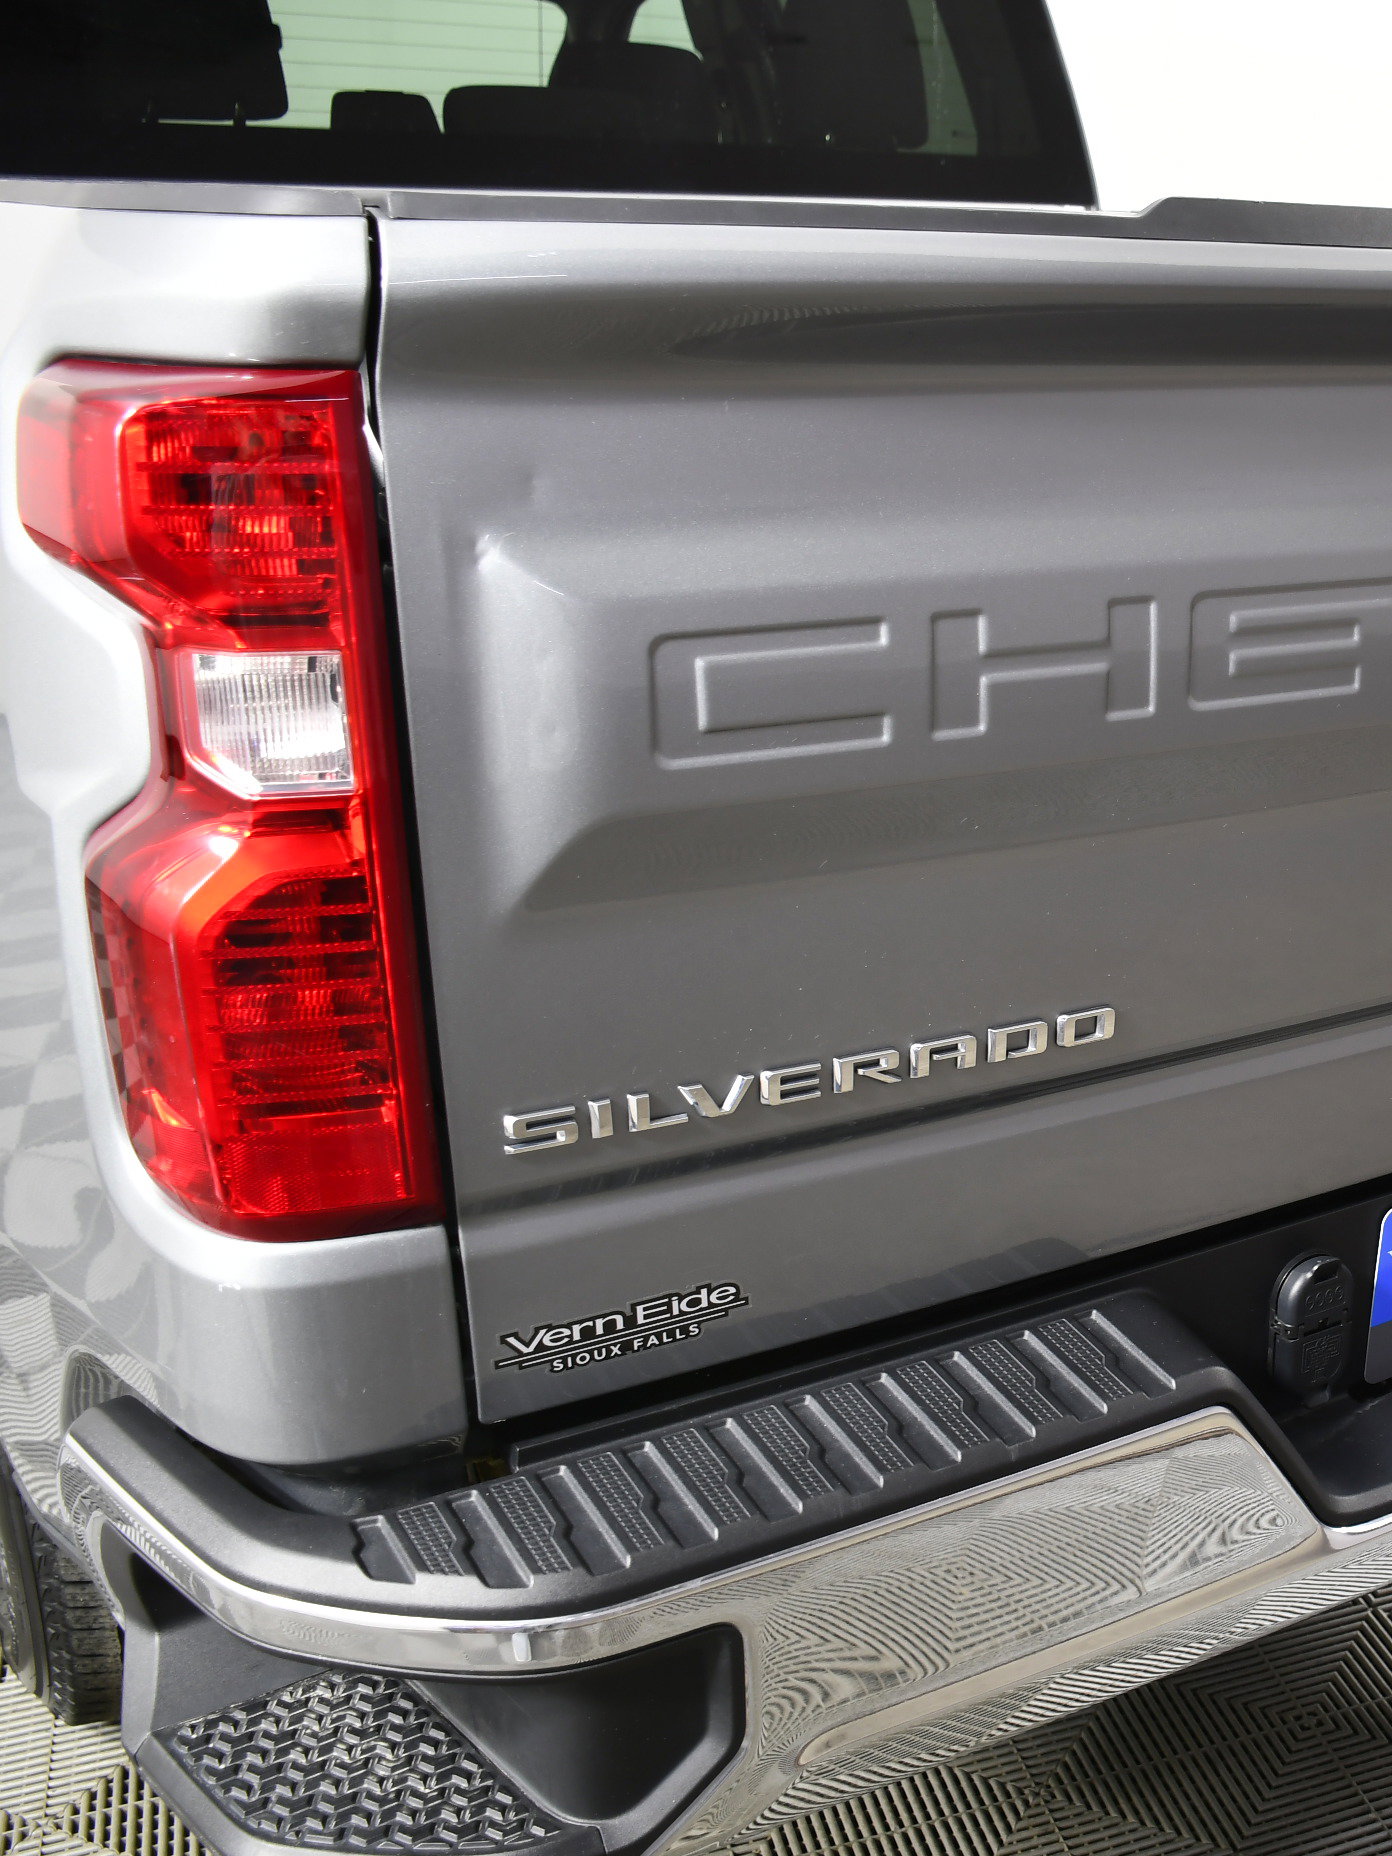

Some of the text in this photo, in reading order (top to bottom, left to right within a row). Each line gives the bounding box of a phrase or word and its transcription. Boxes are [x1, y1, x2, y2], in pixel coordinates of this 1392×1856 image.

[502, 1006, 1116, 1155] SILVERADO
[504, 1284, 738, 1355] Vern Eide
[552, 1323, 700, 1371] SIOUX FALLS
